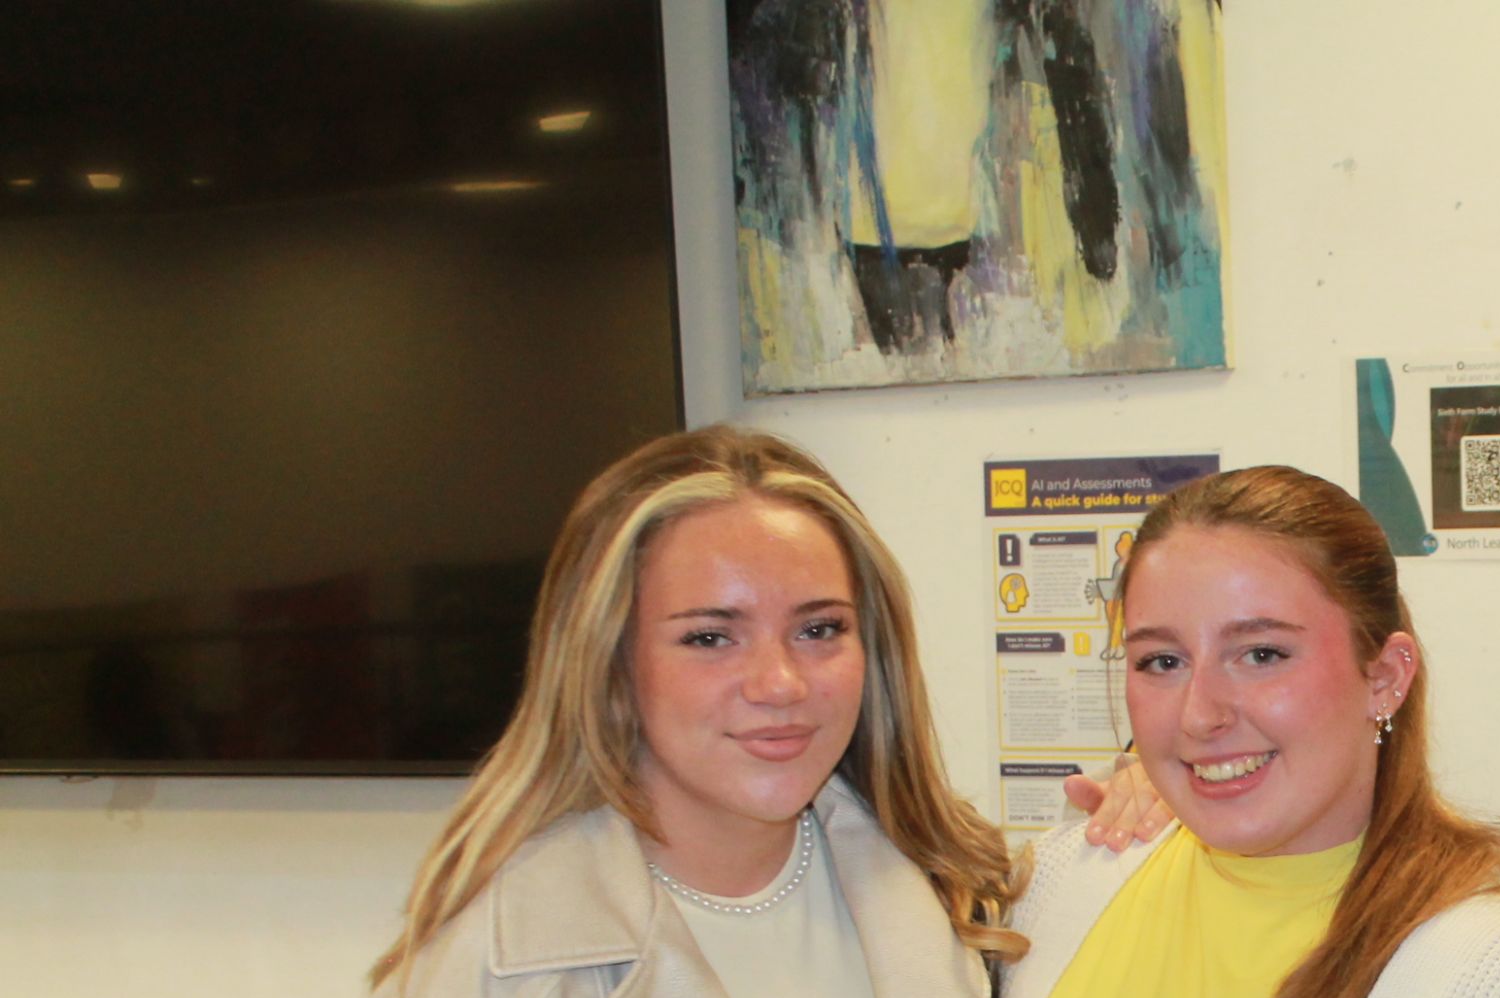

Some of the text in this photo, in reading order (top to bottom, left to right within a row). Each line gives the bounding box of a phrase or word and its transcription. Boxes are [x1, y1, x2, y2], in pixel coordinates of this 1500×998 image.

[994, 479, 1024, 497] JCQ
[1031, 477, 1152, 491] AI and Assessments
[1031, 495, 1042, 508] A
[1044, 494, 1080, 510] quick
[1083, 492, 1120, 509] guide
[1123, 492, 1142, 505] for
[1447, 537, 1480, 549] North
